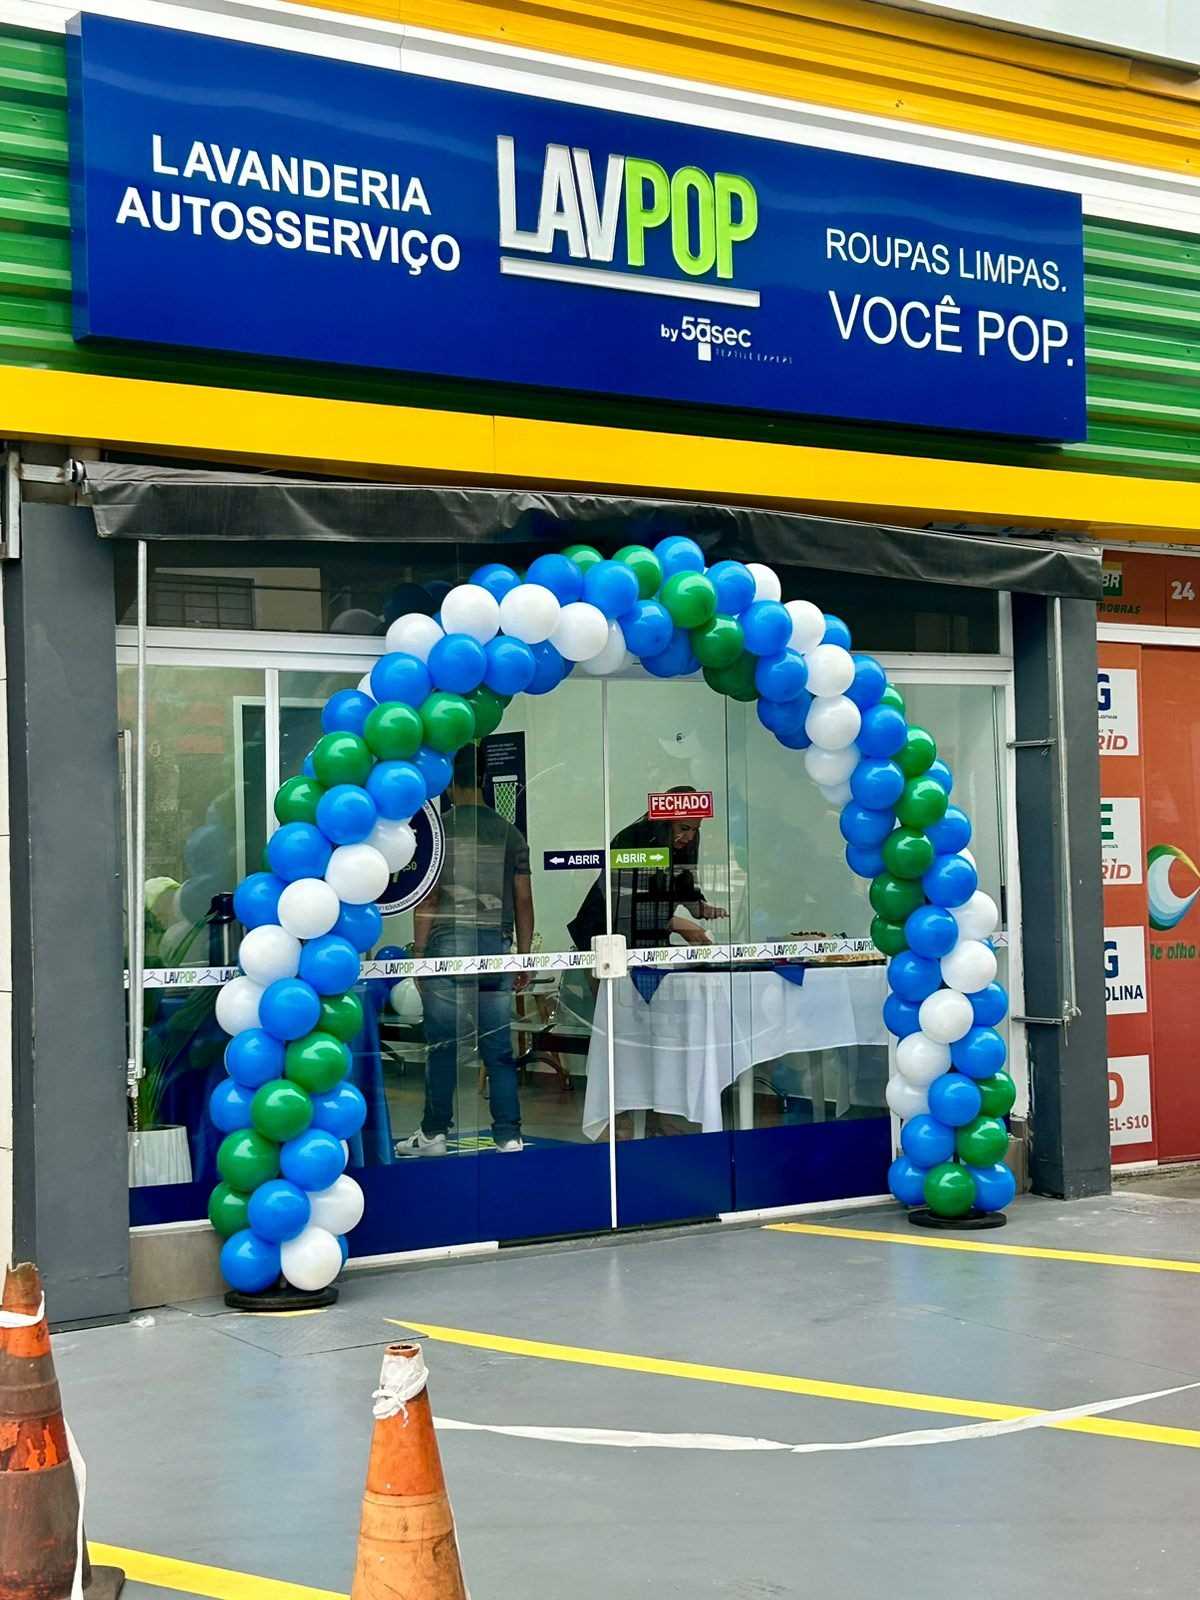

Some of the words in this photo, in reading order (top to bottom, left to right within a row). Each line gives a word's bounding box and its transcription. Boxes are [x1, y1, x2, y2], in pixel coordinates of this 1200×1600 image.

[152, 134, 431, 215] LAVANDERIA
[497, 135, 758, 279] LAVPOP
[116, 187, 461, 275] AUTOSSERVIÇO
[826, 228, 950, 275] ROUPAS
[959, 248, 1067, 292] LIMPAS.
[660, 324, 679, 342] by
[828, 290, 962, 353] VOCÊ
[978, 310, 1074, 367] POP.
[1171, 581, 1196, 600] 24
[652, 795, 709, 811] FECHADO
[568, 854, 600, 866] ABRIR
[616, 853, 647, 864] ABRIR
[643, 950, 669, 963] LAVPOP
[686, 948, 712, 960] LAVPOP
[732, 946, 757, 958] LAVPOP
[773, 943, 798, 956] LAVPOP
[814, 942, 838, 954] LAVPOP
[385, 962, 415, 975] LAVPOP
[435, 960, 463, 973] LAVPOP
[522, 956, 550, 969] LAVPOP
[164, 971, 196, 984] LAVPOP
